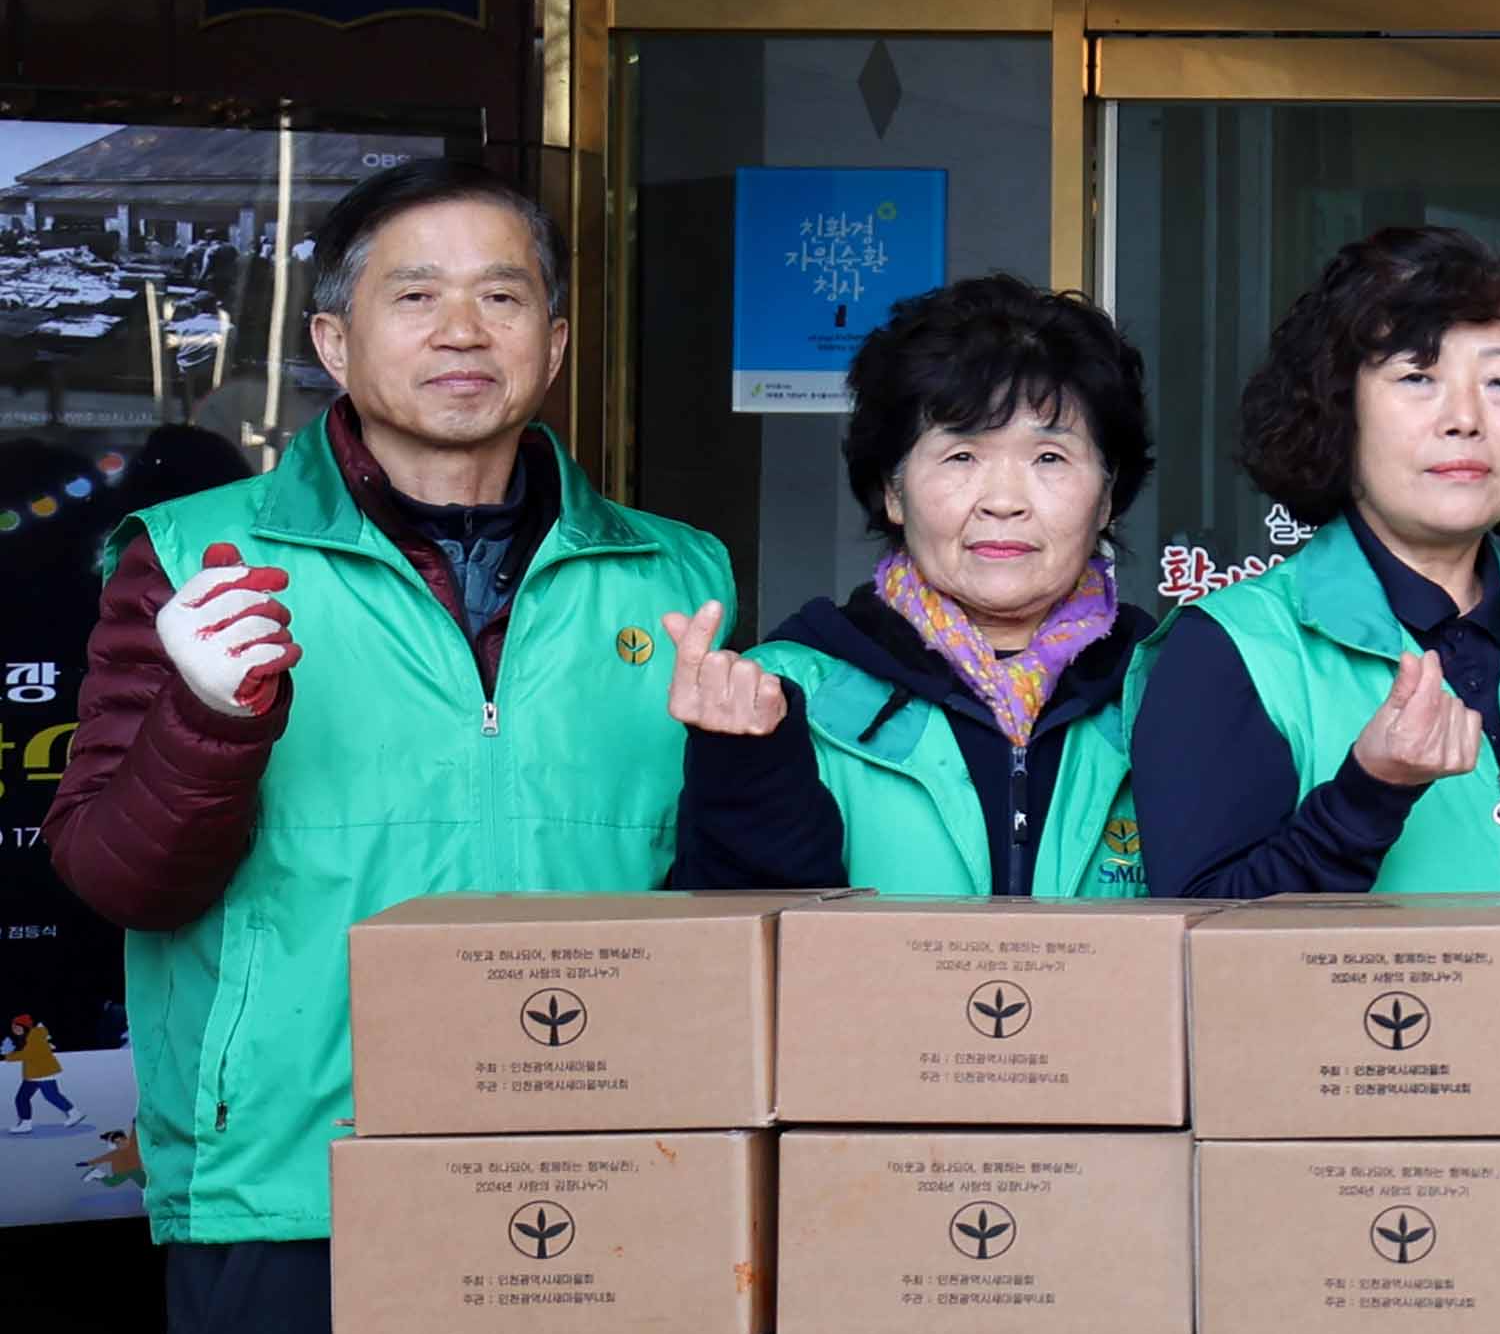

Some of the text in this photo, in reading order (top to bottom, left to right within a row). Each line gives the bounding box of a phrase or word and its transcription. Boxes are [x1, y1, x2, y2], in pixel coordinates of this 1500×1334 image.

[799, 210, 876, 244] 친환경
[783, 240, 889, 274] 자원순환
[812, 269, 865, 303] 청사
[550, 947, 594, 961] 함께하는
[1393, 951, 1438, 965] 함께하는
[487, 966, 621, 980] 2024년 사랑의 김장나누기
[1330, 970, 1464, 984] 2024년 사랑의 김장나누기
[510, 1060, 608, 1074] 인천광역시새마을회
[1352, 1063, 1450, 1077] 인천광역시새마을회
[510, 1079, 630, 1092] 인천광역시새마을부녀회
[1353, 1081, 1472, 1096] 인천광역시새마을부녀회
